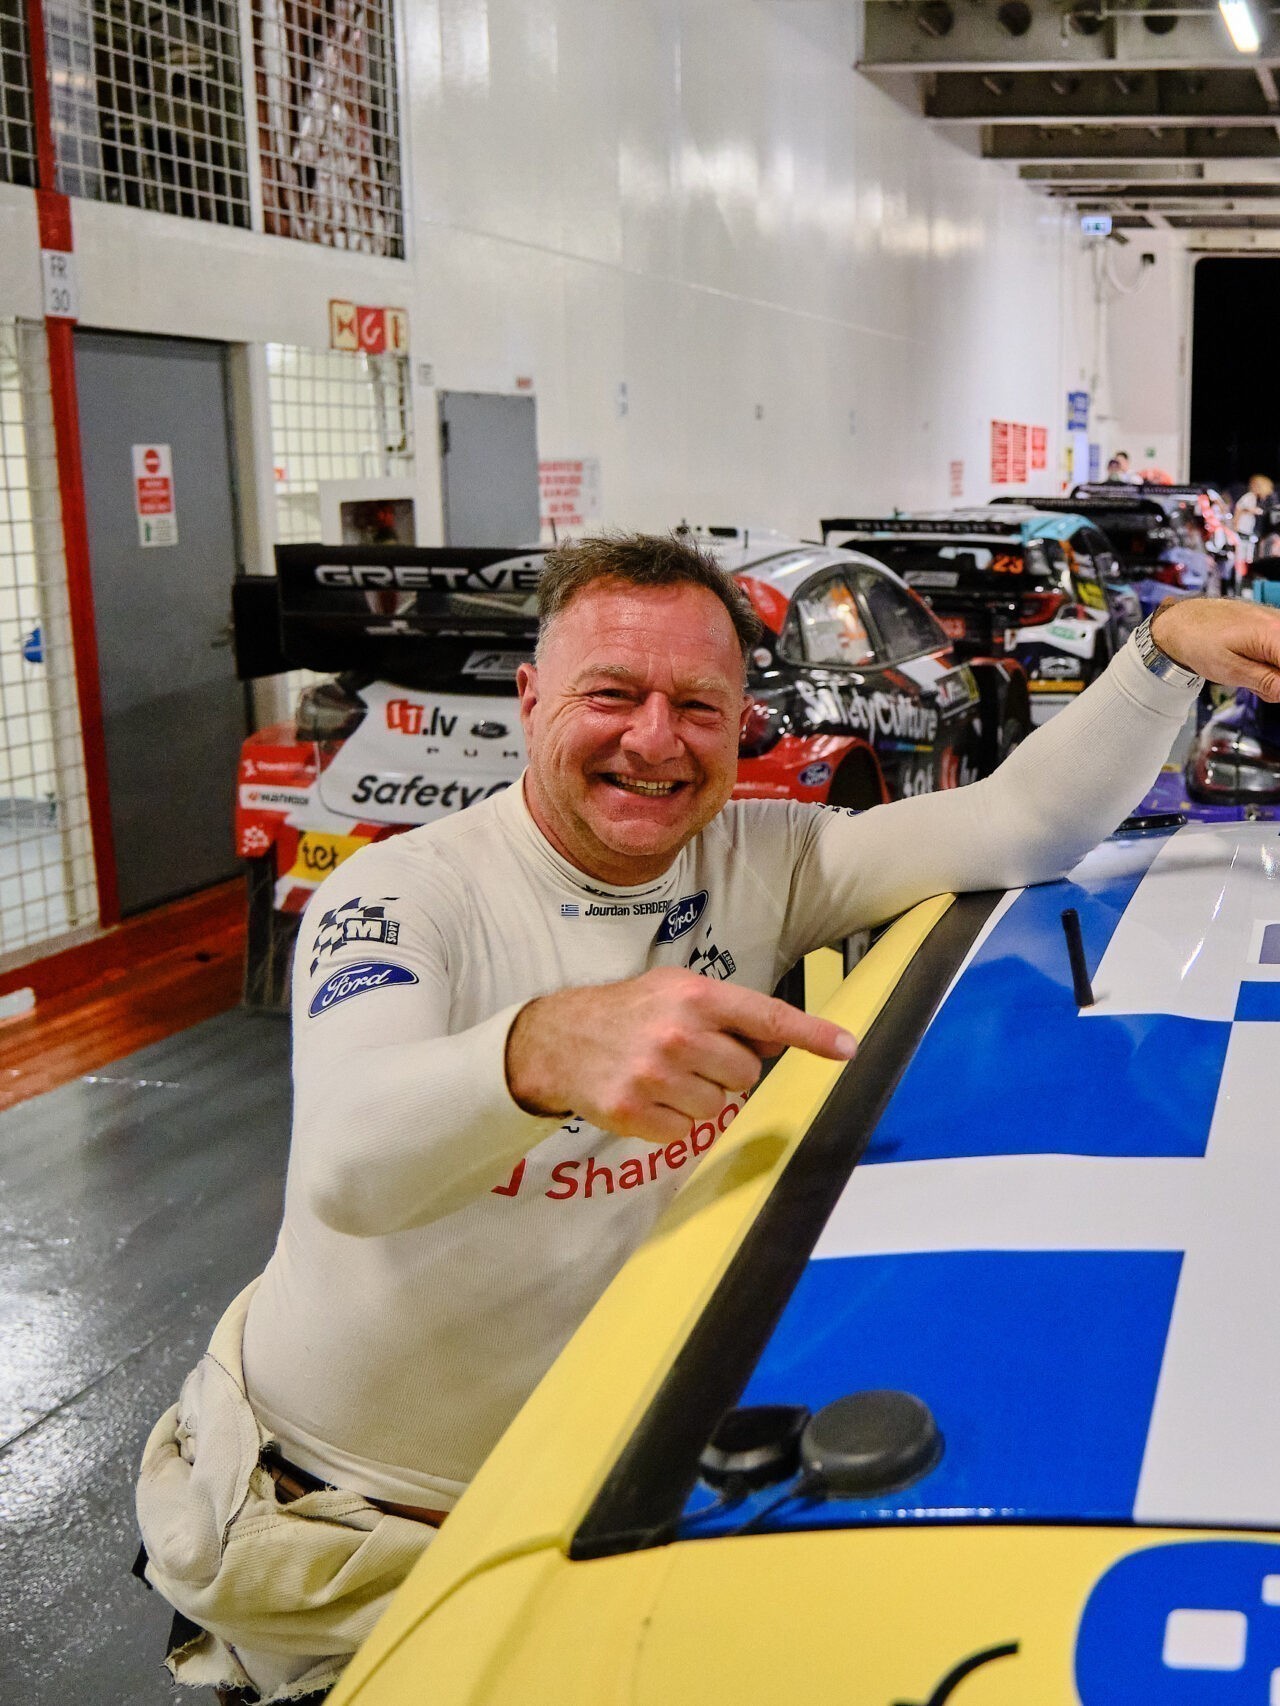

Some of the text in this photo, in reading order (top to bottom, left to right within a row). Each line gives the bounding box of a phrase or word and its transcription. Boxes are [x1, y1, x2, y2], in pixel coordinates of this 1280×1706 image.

[992, 555, 1025, 575] 23
[585, 900, 670, 916] Jourdan SERDER
[321, 966, 393, 1007] Ford
[545, 1101, 743, 1200] Sharebo
